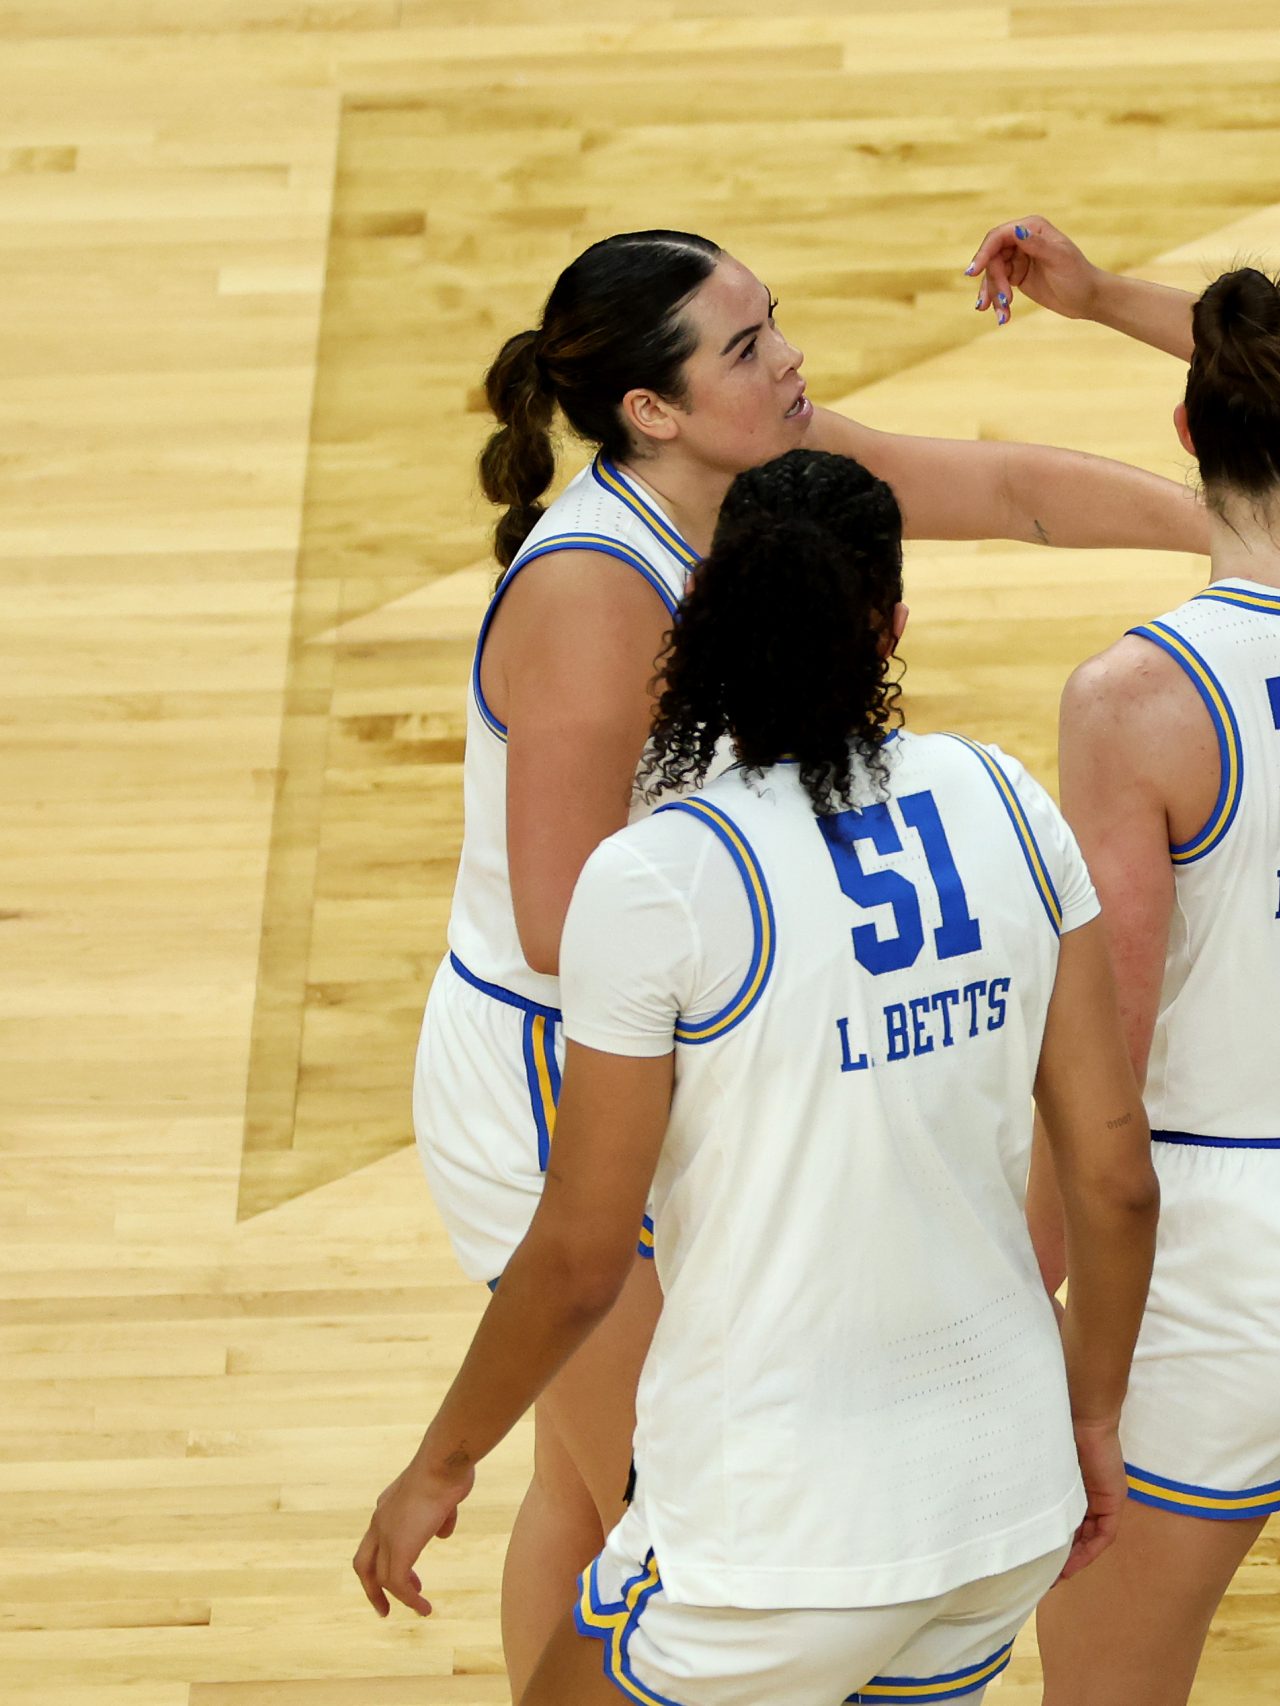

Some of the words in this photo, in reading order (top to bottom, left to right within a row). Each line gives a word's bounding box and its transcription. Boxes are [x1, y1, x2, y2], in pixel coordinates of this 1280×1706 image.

[815, 789, 983, 976] 51
[836, 1017, 875, 1073] L
[883, 977, 1011, 1062] BETTS
